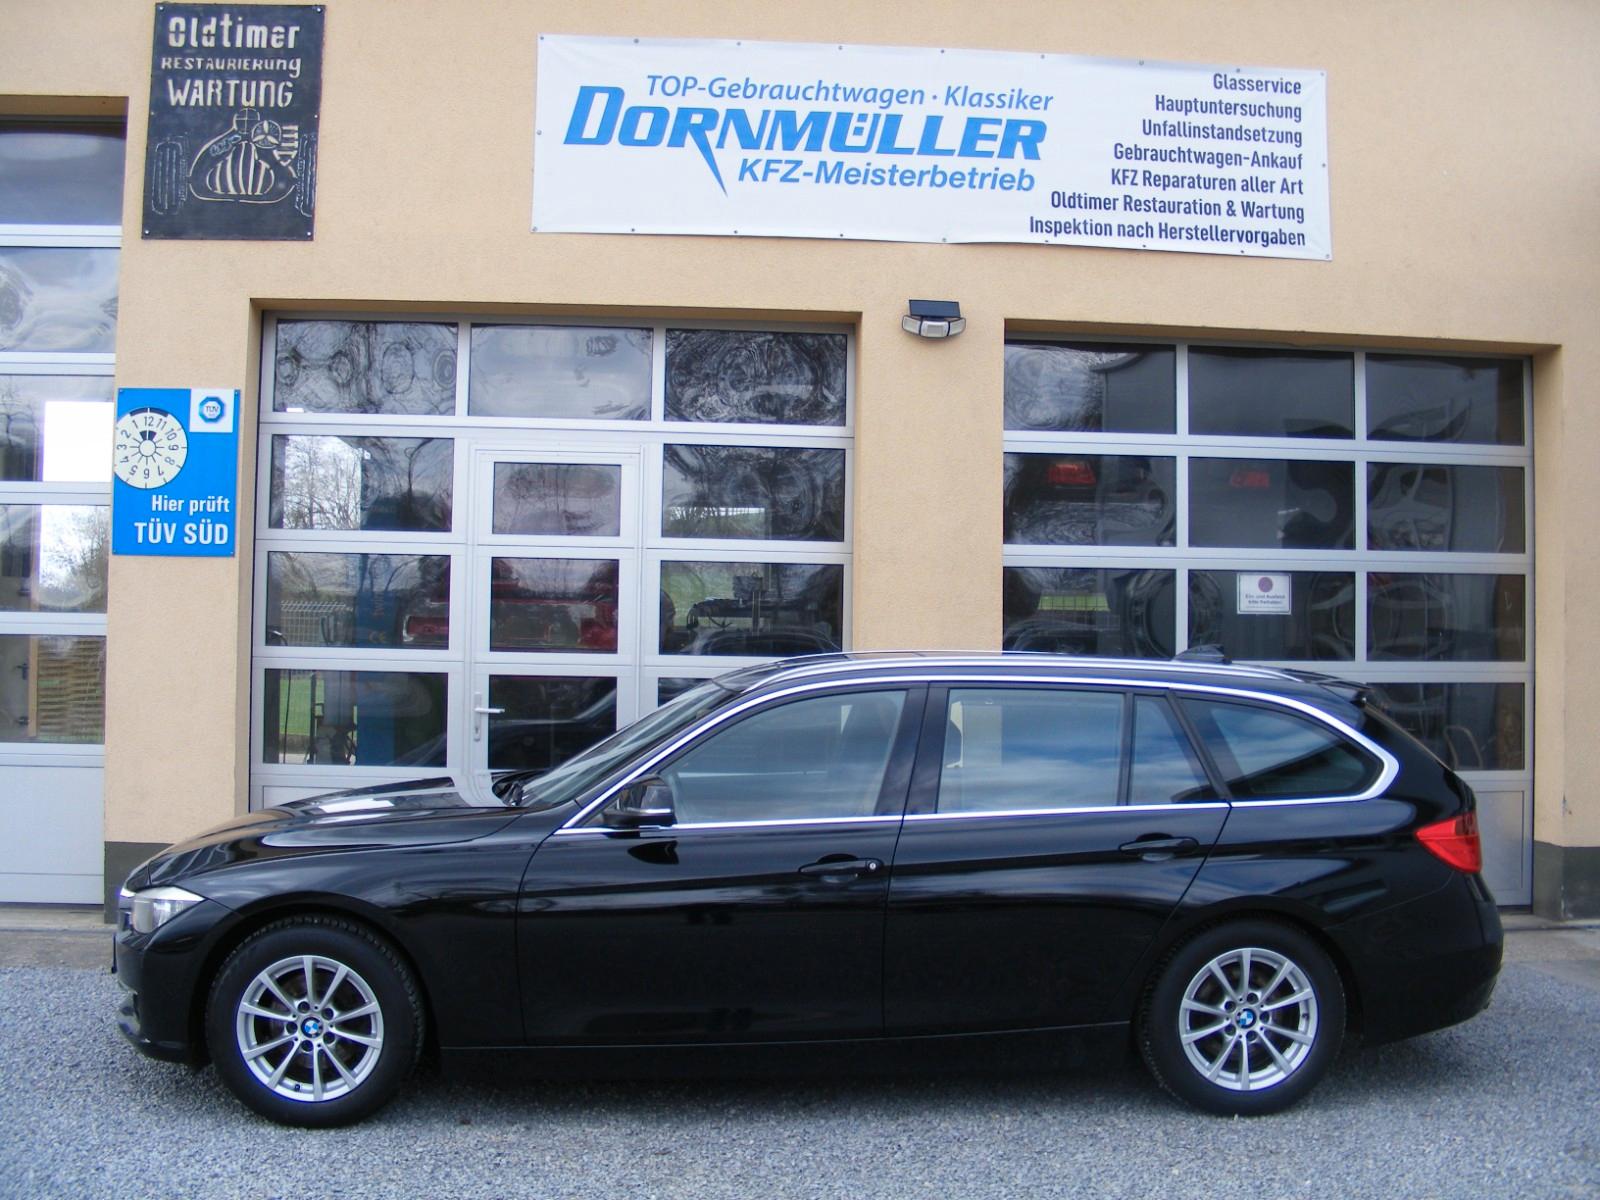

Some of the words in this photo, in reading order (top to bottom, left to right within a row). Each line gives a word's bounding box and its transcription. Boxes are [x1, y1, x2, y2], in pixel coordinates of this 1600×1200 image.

[168, 13, 300, 49] Oldtimer
[647, 75, 925, 110] TOP-Gebrauchtwagen
[944, 85, 1054, 111] Klassiker
[1213, 73, 1302, 95] Glasservice
[1155, 94, 1302, 122] Hauptuntersuchung
[1142, 119, 1303, 147] Unfallinstandsetzung
[1113, 142, 1303, 169] Gebrauchtwagen-Ankauf
[738, 158, 1036, 193] KFZ-Meisterbetrieb
[1111, 168, 1139, 187] KFZ
[1142, 170, 1236, 191] Reparaturen
[1240, 175, 1276, 193] aller
[1279, 177, 1304, 195] Art
[1050, 190, 1119, 211] Oldtimer
[1123, 195, 1222, 217] Restauration
[1226, 200, 1237, 217] &
[1241, 200, 1305, 224] Wartung
[1029, 216, 1113, 238] Inspektion
[1117, 221, 1154, 239] nach
[1158, 222, 1306, 247] Herstellervorgaben
[143, 415, 154, 427] 12
[151, 494, 185, 512] Hier
[189, 495, 230, 516] prüft
[134, 518, 177, 545] TÜV
[184, 518, 229, 545] SÜD
